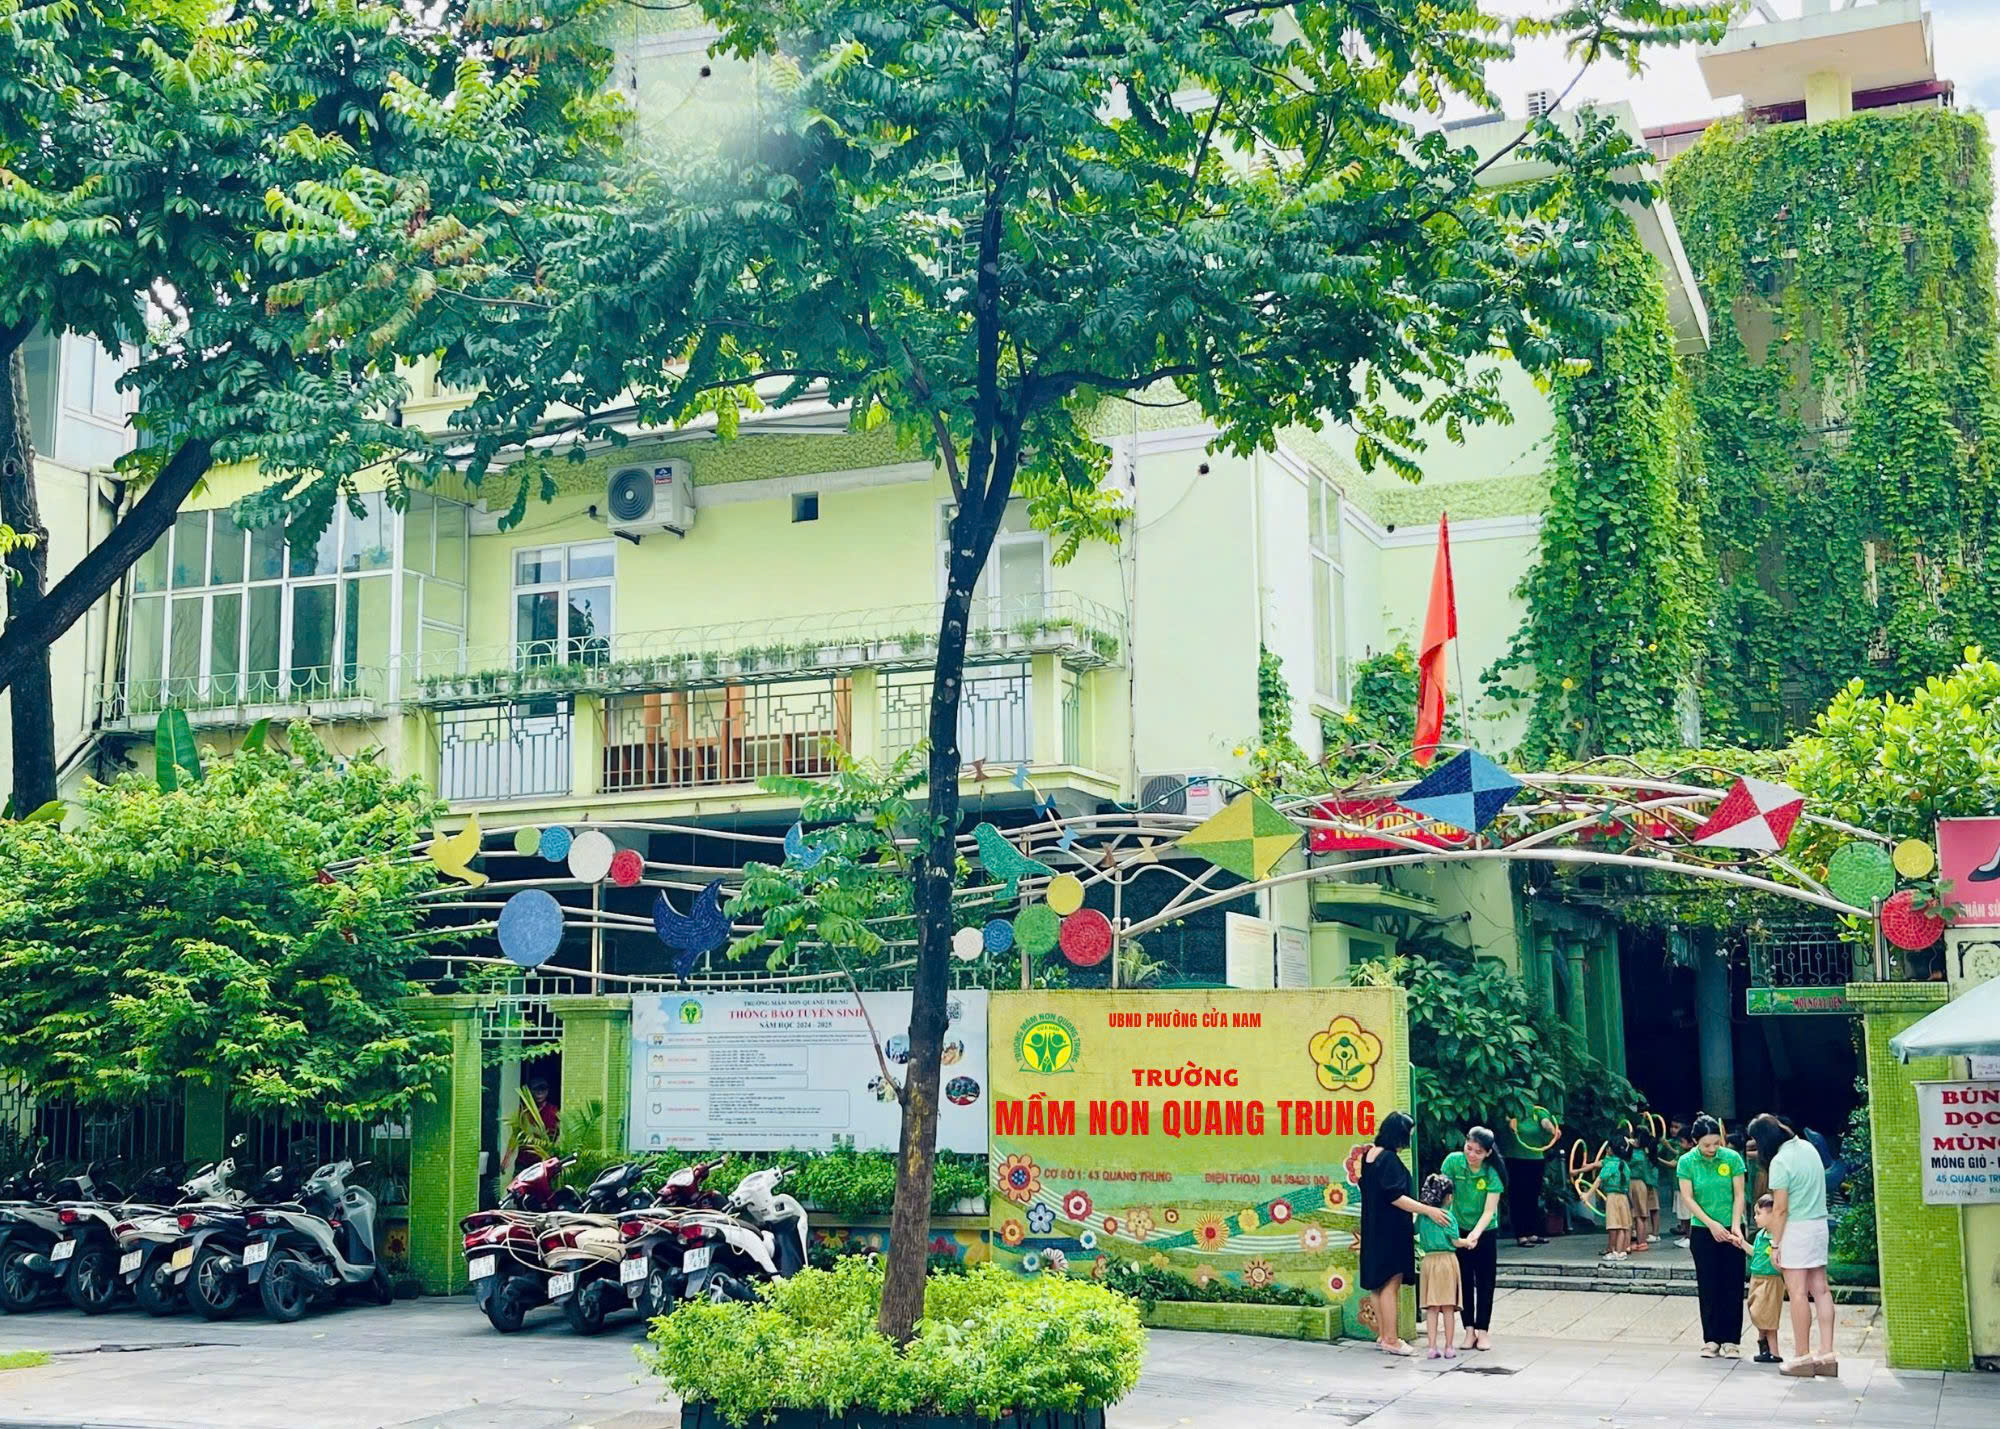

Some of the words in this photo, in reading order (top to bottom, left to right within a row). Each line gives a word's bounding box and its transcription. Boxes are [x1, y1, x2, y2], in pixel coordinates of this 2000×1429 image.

[729, 1008, 768, 1019] THÔNG
[771, 1007, 794, 1018] BÁO
[797, 1006, 834, 1018] TUYỂN
[837, 1008, 865, 1017] SINH
[1109, 1013, 1142, 1027] UBND
[1146, 1009, 1198, 1027] PHƯỜNG
[1202, 1008, 1228, 1027] CỬA
[1232, 1013, 1261, 1027] NAM
[759, 1020, 777, 1028] NĂM
[778, 1021, 793, 1030] HỌC
[1131, 1060, 1239, 1087] TRƯỜNG
[1941, 1087, 2000, 1104] BÚN
[995, 1091, 1076, 1136] MẦM
[1089, 1100, 1149, 1136] NON
[1162, 1100, 1265, 1139] QUANG
[1277, 1100, 1375, 1136] TRUNG
[1944, 1111, 2000, 1128] DỌC
[1932, 1133, 2000, 1151] MÙN
[1931, 1154, 1965, 1169] MÓNG
[1102, 1170, 1137, 1182] QUANG
[1139, 1171, 1173, 1182] TRUNG
[1936, 1174, 1947, 1183] 45
[1950, 1174, 1986, 1183] QUANG
